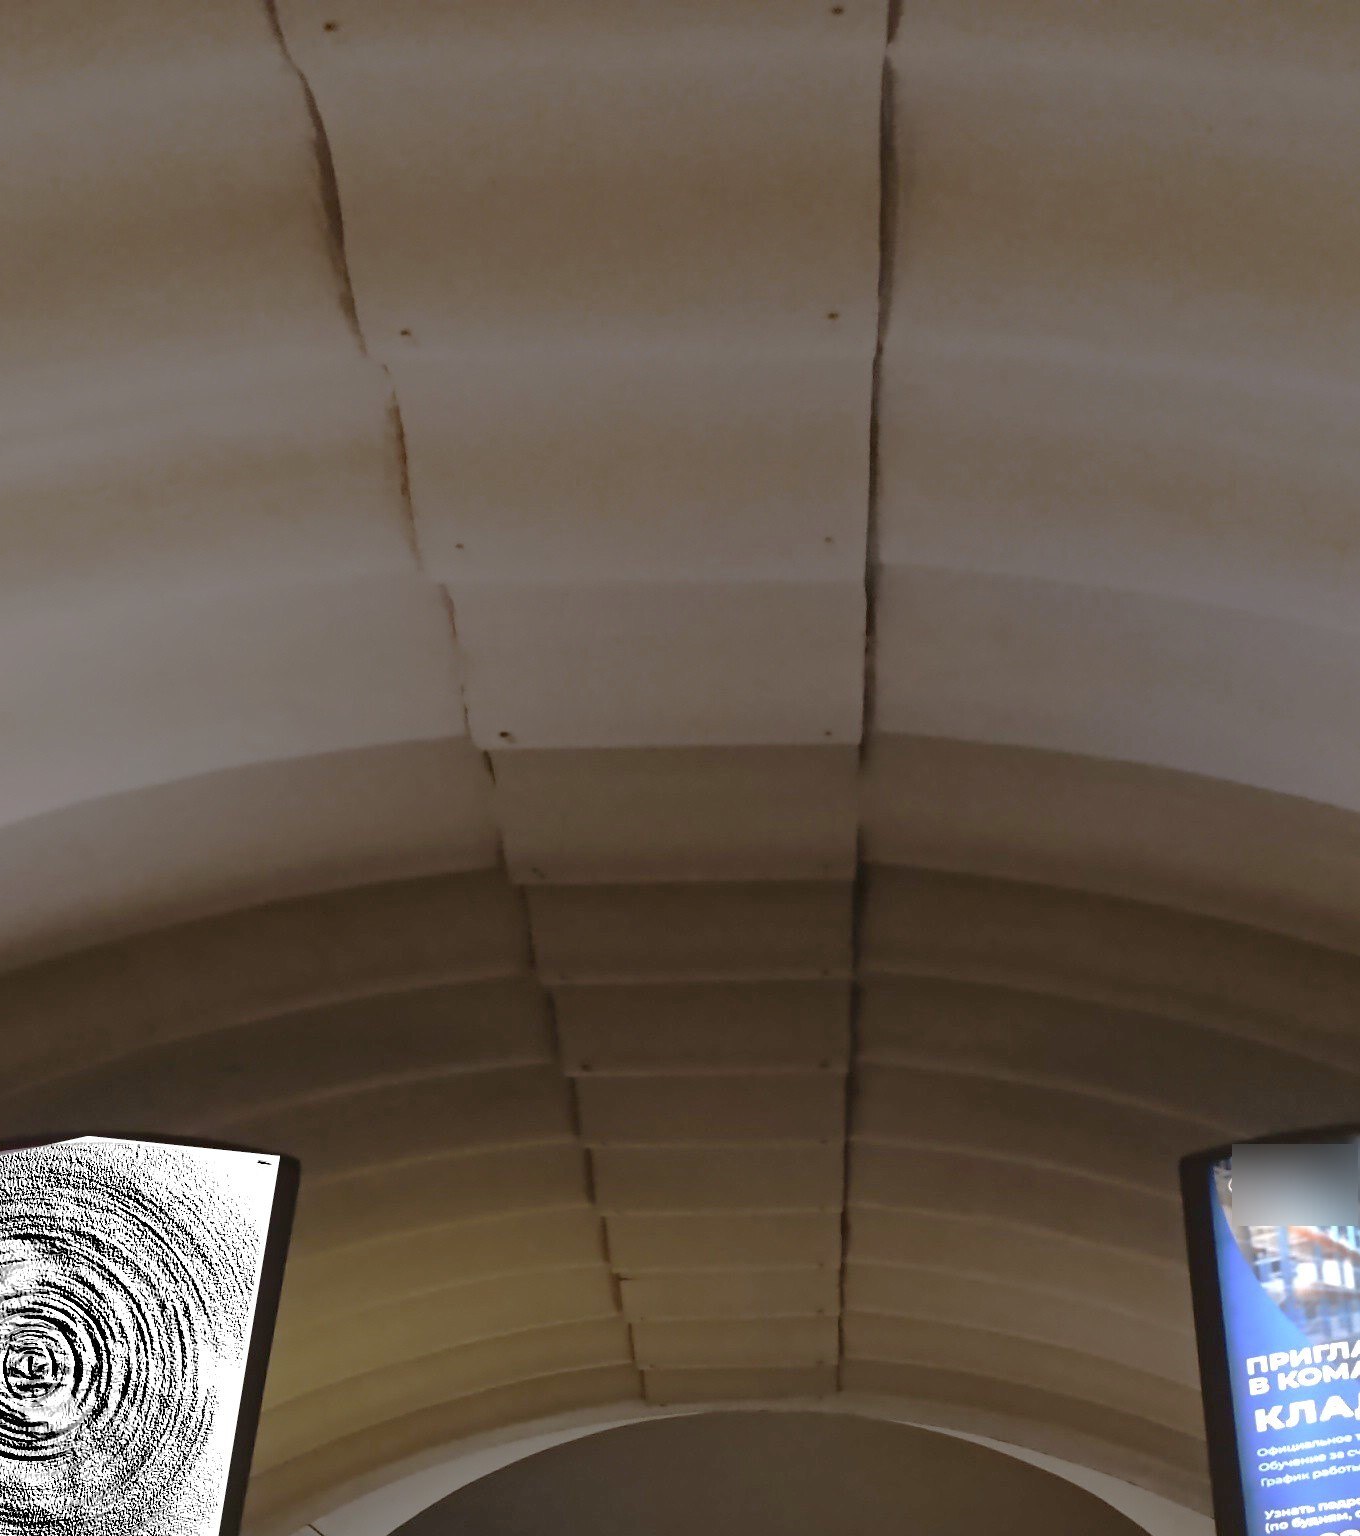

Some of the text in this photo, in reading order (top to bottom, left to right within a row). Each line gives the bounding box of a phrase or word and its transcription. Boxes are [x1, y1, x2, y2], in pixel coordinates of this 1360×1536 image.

[1248, 1377, 1270, 1396] В
[1256, 1435, 1353, 1458] Официальное
[1258, 1453, 1327, 1474] Обучение
[1329, 1451, 1345, 1460] за
[1260, 1471, 1310, 1488] График
[1264, 1503, 1315, 1520] Узнать
[1264, 1519, 1288, 1534] (по
[1291, 1511, 1353, 1530] будням,
